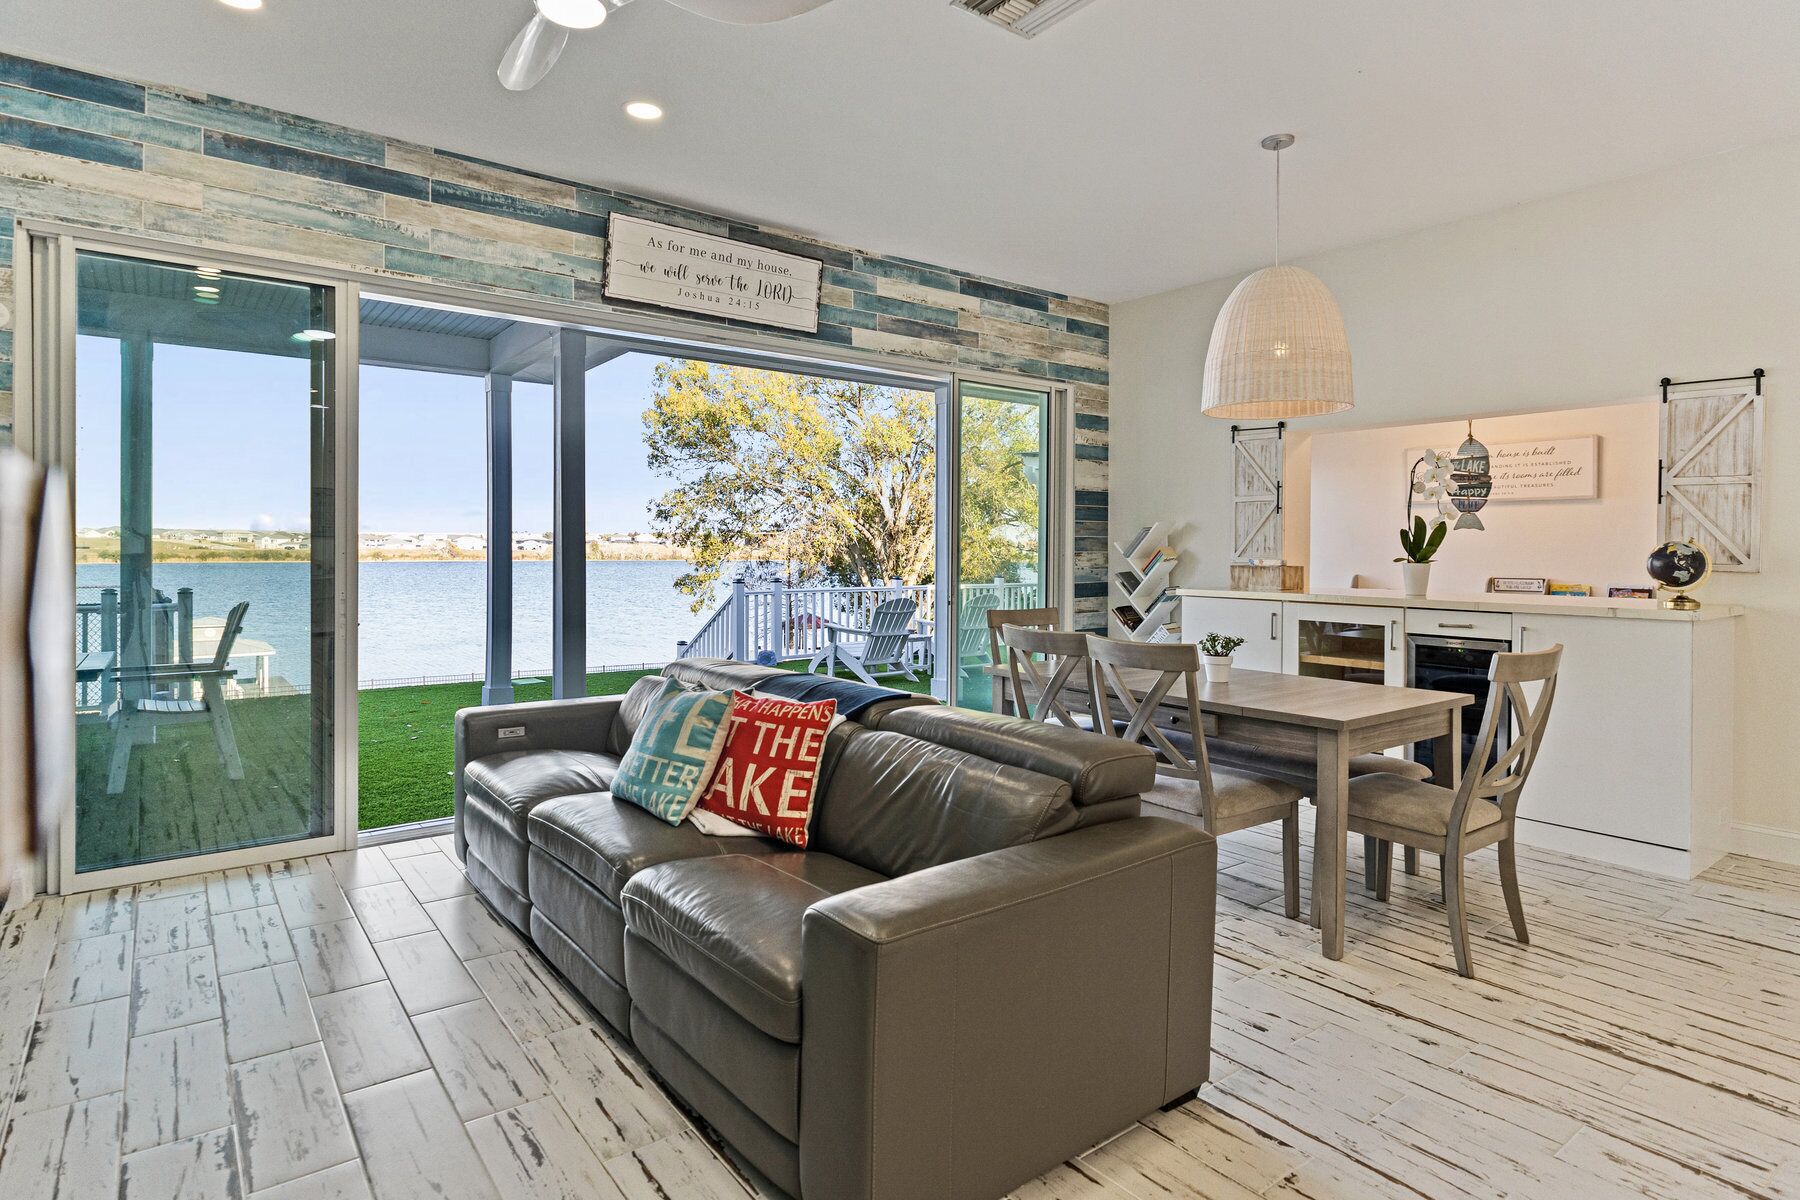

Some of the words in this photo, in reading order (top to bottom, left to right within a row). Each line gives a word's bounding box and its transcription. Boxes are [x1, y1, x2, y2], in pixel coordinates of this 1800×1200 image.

[647, 237, 663, 249] As
[667, 240, 686, 253] for
[689, 247, 707, 258] me
[710, 252, 733, 264] and
[737, 257, 754, 270] my
[664, 264, 689, 281] will
[696, 273, 724, 287] serve
[725, 274, 750, 292] the
[756, 279, 793, 305] LORD
[677, 287, 720, 303] Joshua
[728, 297, 760, 311] 24:15
[1460, 459, 1486, 474] LAKE
[1496, 449, 1520, 459] house
[1522, 450, 1530, 458] is
[1532, 445, 1556, 456] built
[1499, 471, 1510, 480] its
[1512, 472, 1537, 480] rooms
[1553, 466, 1583, 481] filled
[733, 696, 762, 713] HAT
[758, 701, 834, 722] HAPPENS
[726, 715, 748, 747] T
[753, 720, 825, 762] THE
[702, 757, 814, 818] AKE
[641, 788, 687, 821] LAKE
